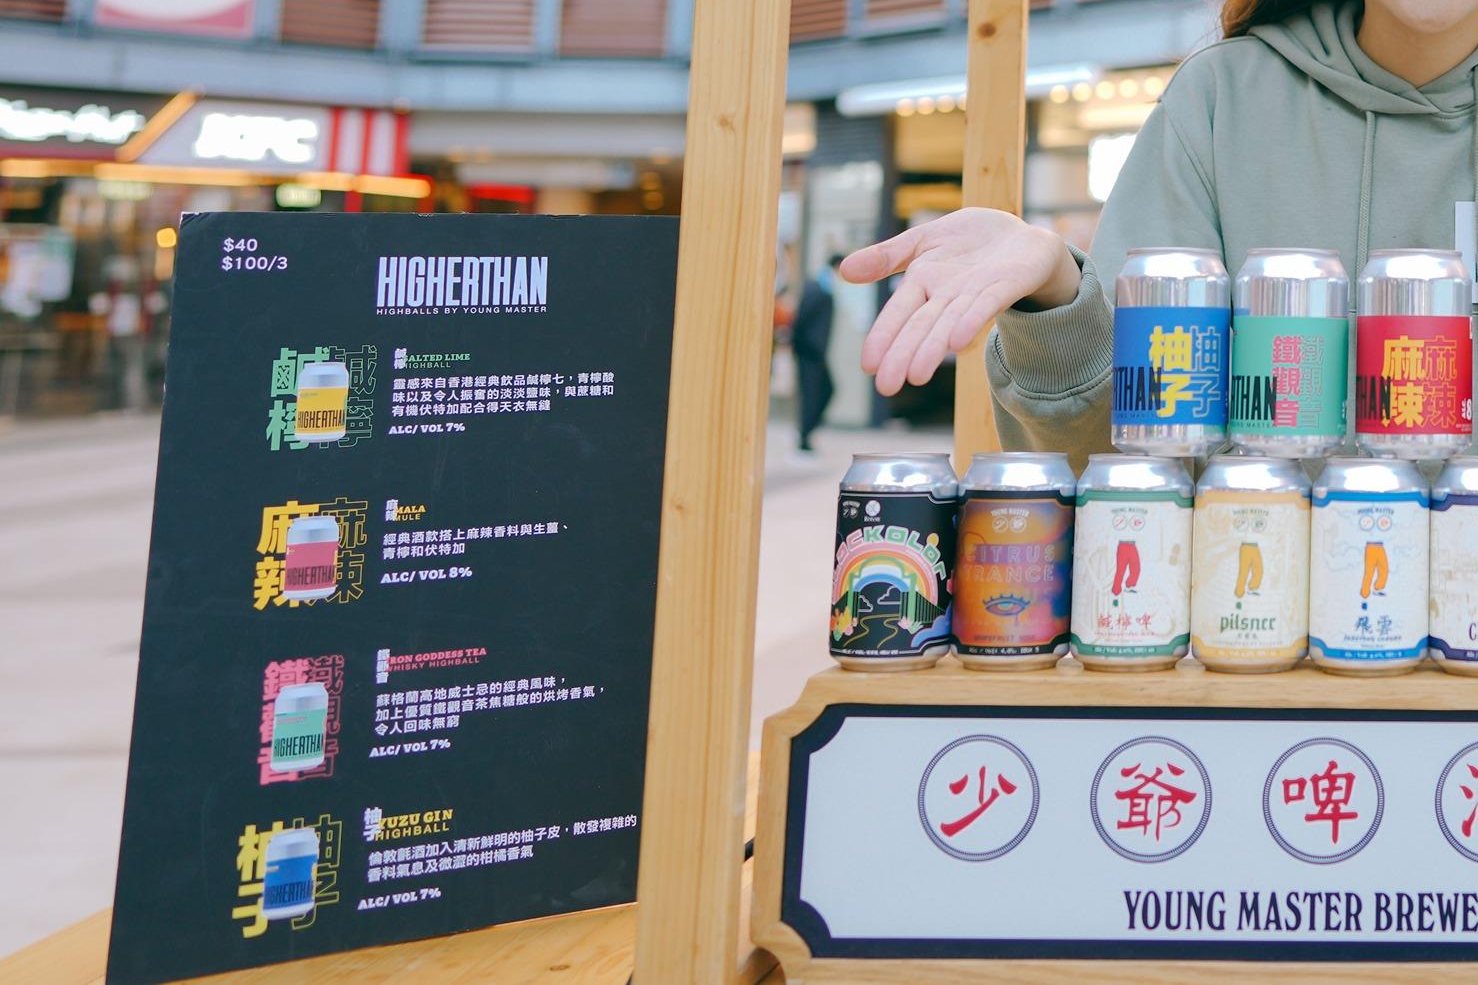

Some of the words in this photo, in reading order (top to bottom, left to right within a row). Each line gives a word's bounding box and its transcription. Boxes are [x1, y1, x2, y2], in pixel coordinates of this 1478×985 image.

[223, 238, 258, 253] $40
[222, 256, 288, 271] $100/3
[376, 256, 549, 308] HIGHERTHAN
[376, 307, 440, 315] HIGHBALLS
[463, 306, 500, 314] YOUNG
[445, 353, 471, 361] LIME
[388, 424, 418, 435] ALC/
[420, 423, 444, 433] VOL
[445, 422, 466, 433] 7%
[382, 542, 466, 560] 青檸和伏特加
[380, 570, 416, 584] ALC/
[418, 568, 447, 581] VOL
[448, 566, 473, 579] 8%
[1220, 613, 1276, 633] pilsner
[415, 649, 464, 662] GODDESS
[465, 647, 488, 657] TEA
[428, 657, 480, 669] HIGHBALL
[369, 745, 401, 758] ALC/
[403, 742, 428, 753] VOL
[429, 738, 451, 750] 7%
[423, 809, 454, 822] GIN
[357, 896, 390, 911] ALC/
[392, 892, 418, 905] VOL
[420, 887, 442, 900] 7%
[1123, 890, 1229, 932] YOUNG
[1238, 890, 1364, 932] MASTER
